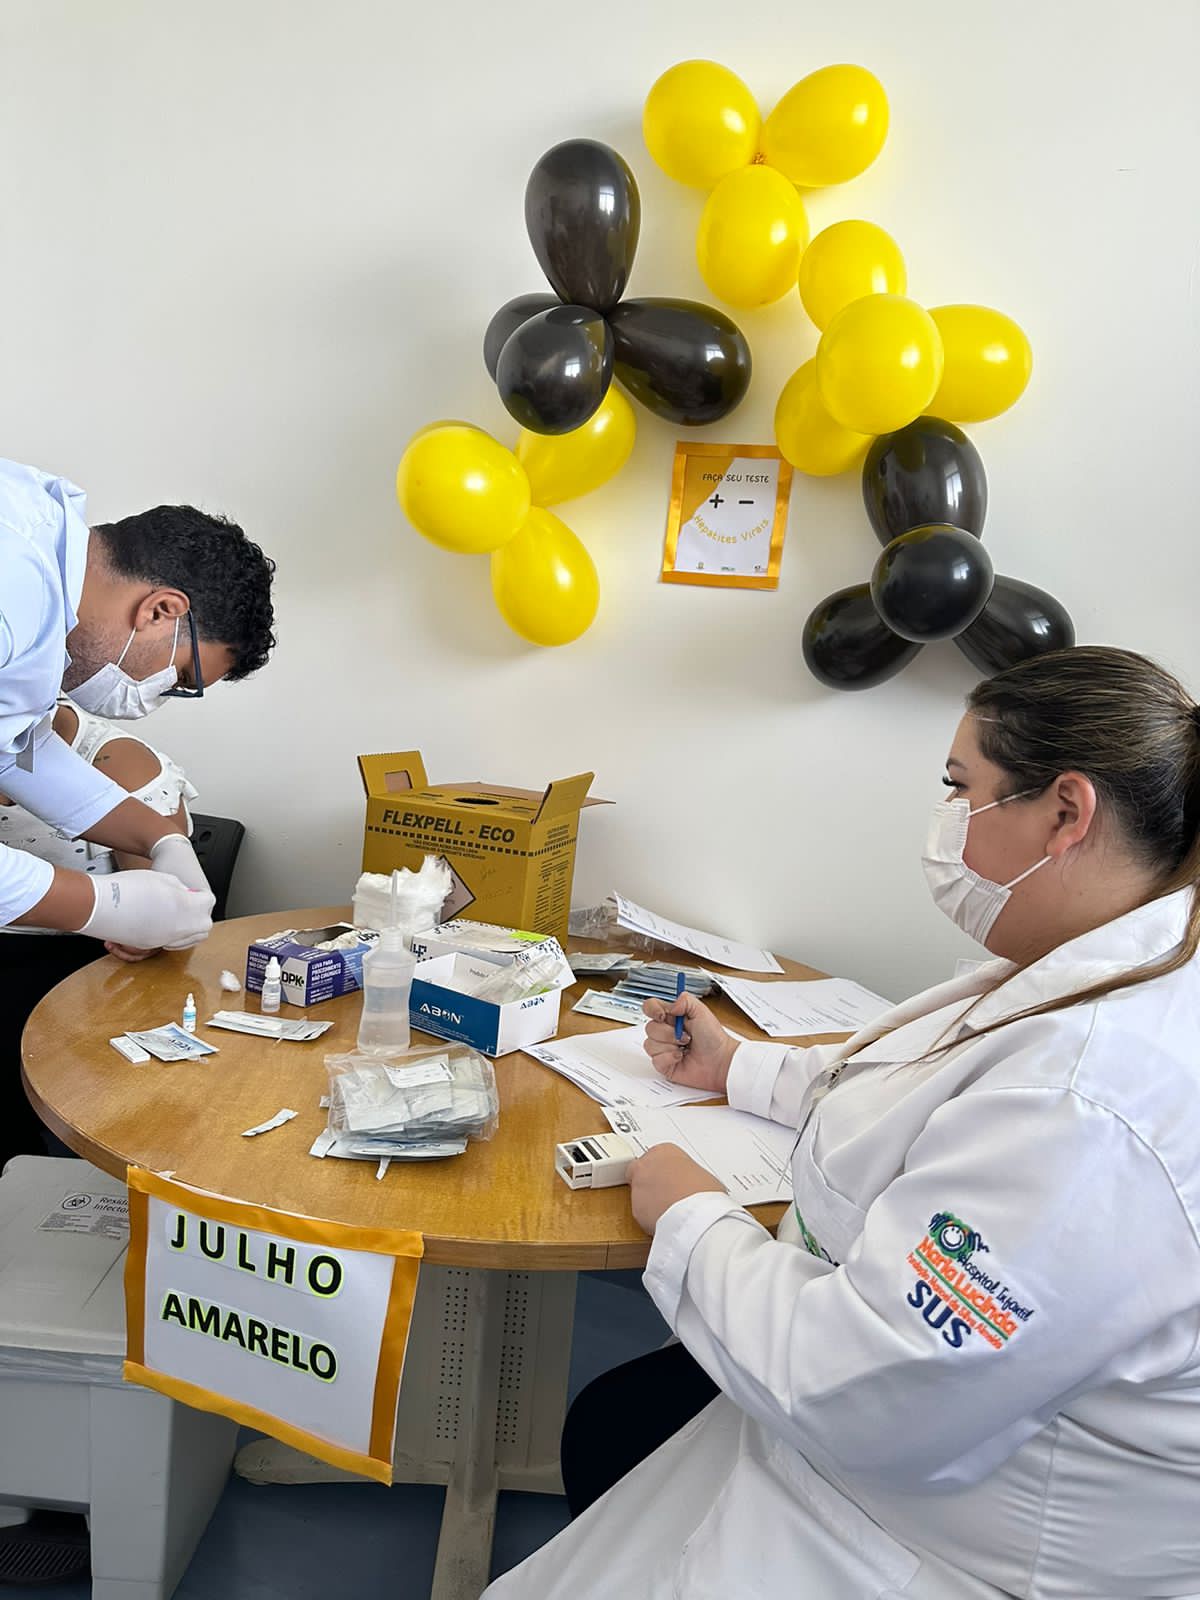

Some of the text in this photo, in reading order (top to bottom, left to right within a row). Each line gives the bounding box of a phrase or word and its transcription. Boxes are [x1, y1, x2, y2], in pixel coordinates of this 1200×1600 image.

[702, 473, 769, 483] FAÇA SEU TESTE
[694, 515, 769, 543] Hepatites Virais
[382, 808, 464, 836] FLEXPELL
[478, 825, 516, 844] ECO
[907, 1278, 972, 1349] SUS
[917, 1236, 1019, 1337] Maria Lucinda
[957, 1252, 1035, 1322] Hospital Infantil
[161, 1292, 338, 1380] AMARELO
